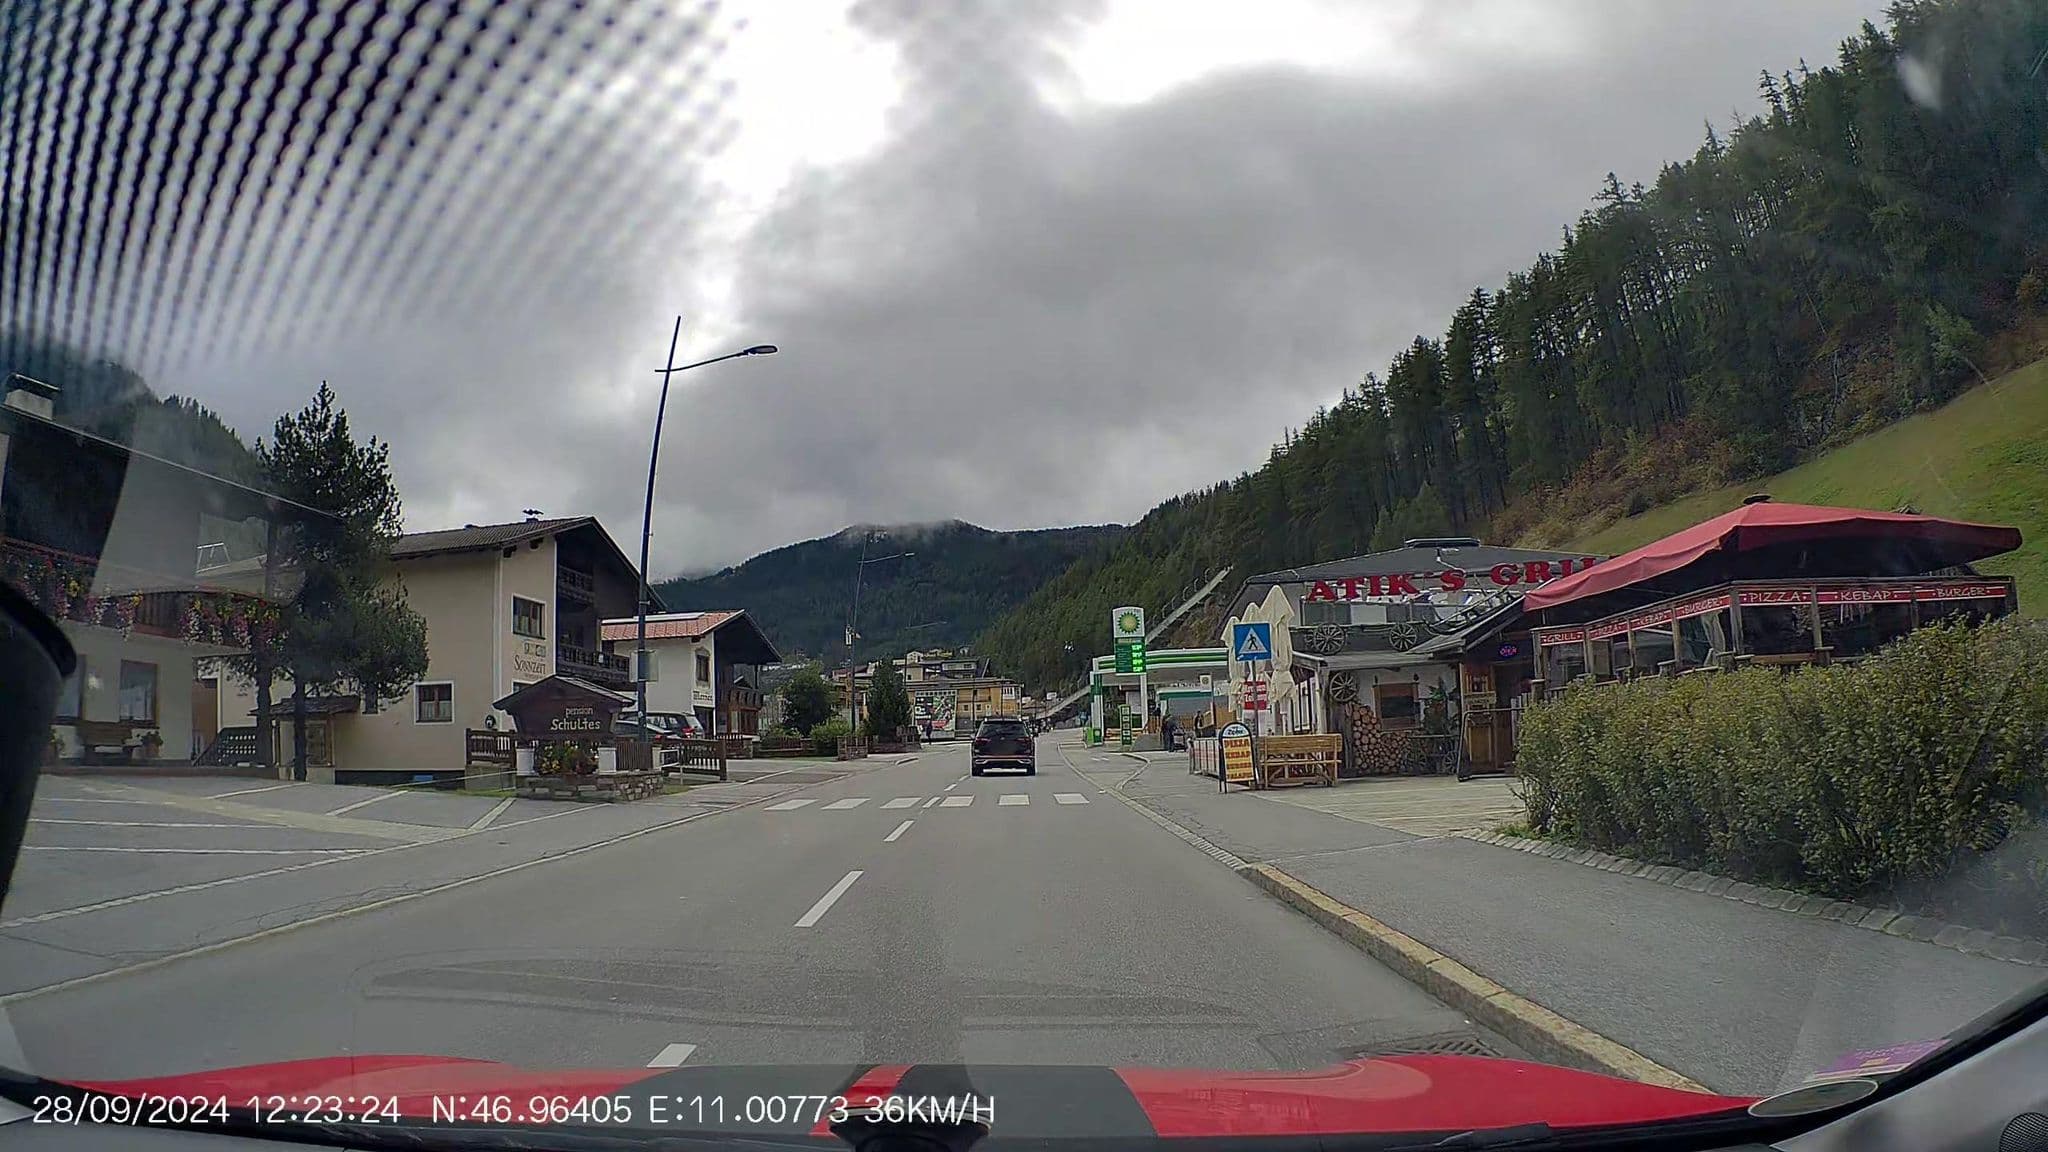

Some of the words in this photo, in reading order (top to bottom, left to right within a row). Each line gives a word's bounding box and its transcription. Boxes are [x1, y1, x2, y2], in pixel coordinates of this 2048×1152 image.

[1490, 556, 1618, 585] GRI
[1749, 591, 1801, 602] PIZZA
[1840, 590, 1891, 601] KEBAP
[1936, 587, 1987, 598] BURGER
[1684, 598, 1721, 615] BURGER
[1640, 612, 1665, 625] KEBAP
[1547, 633, 1577, 643] GRILL
